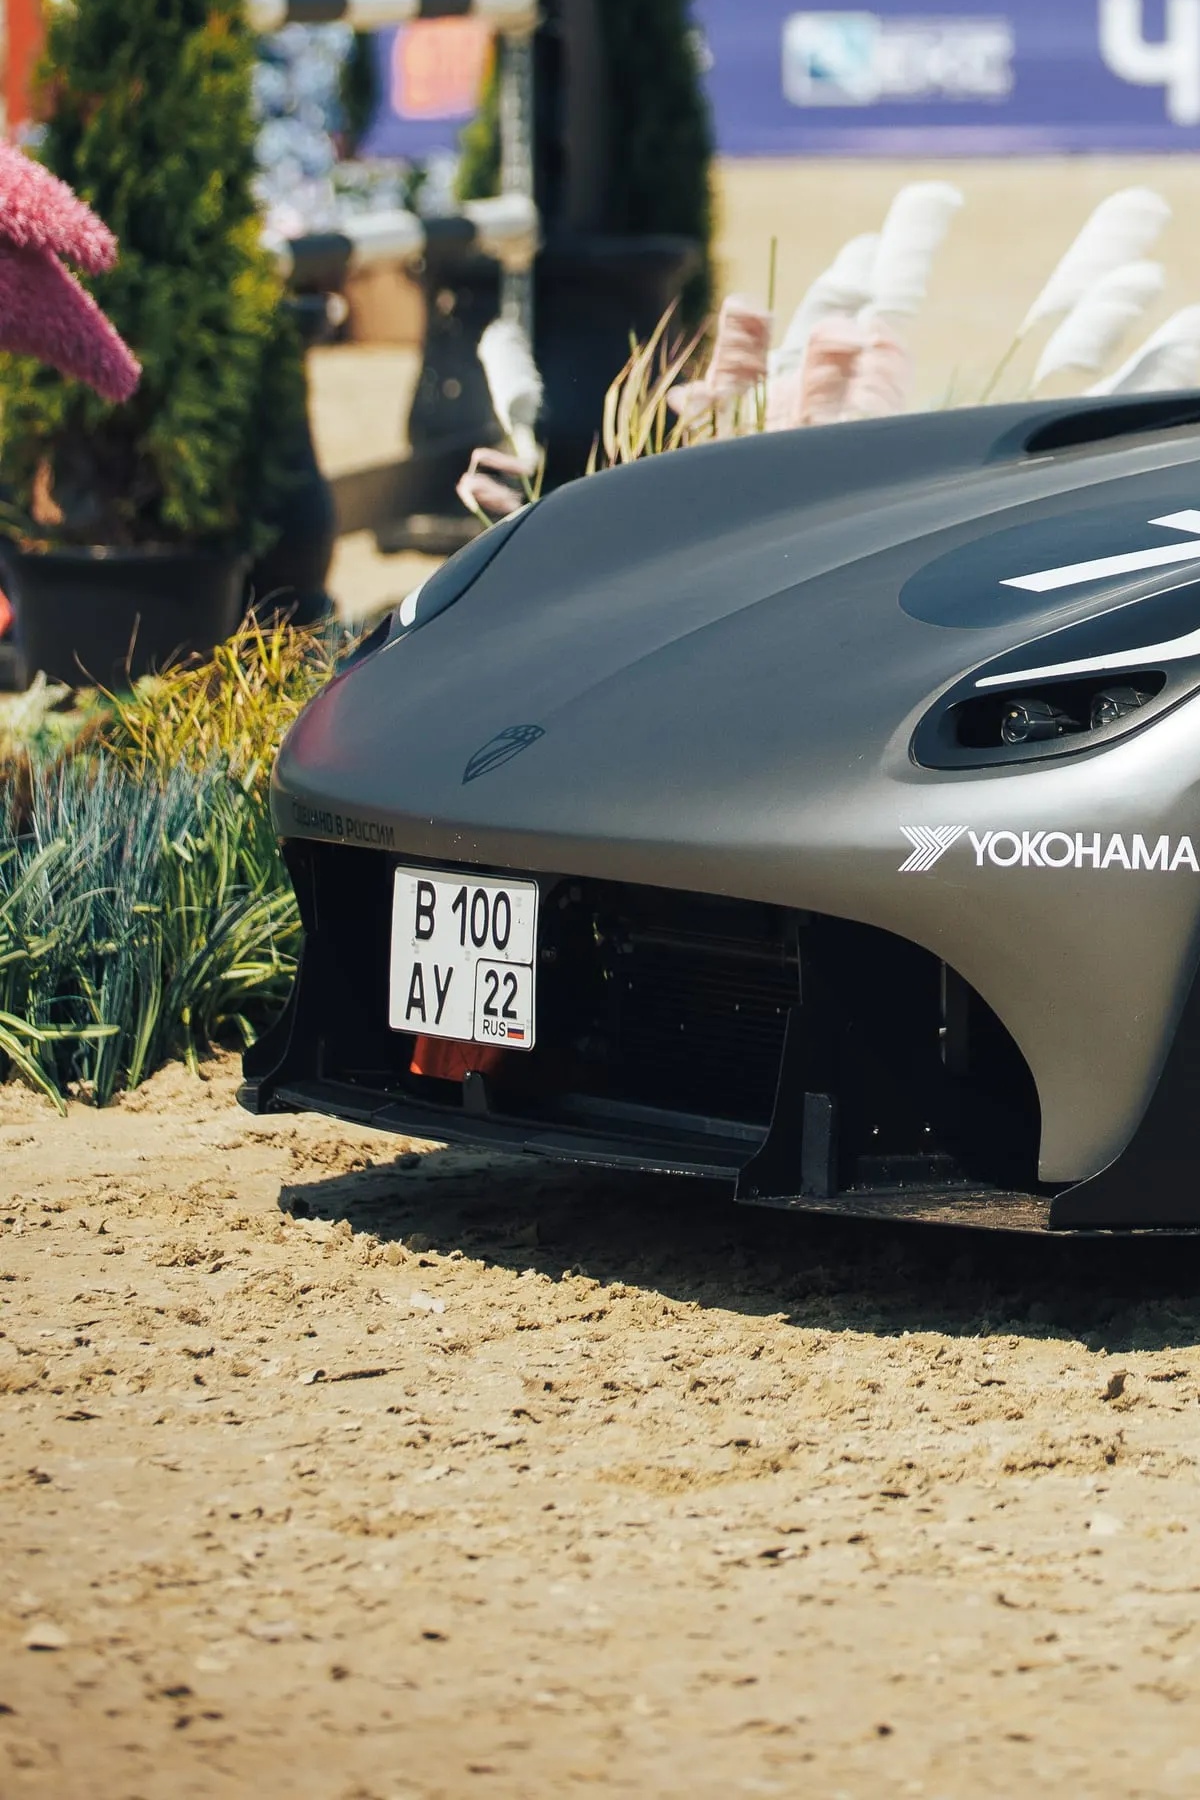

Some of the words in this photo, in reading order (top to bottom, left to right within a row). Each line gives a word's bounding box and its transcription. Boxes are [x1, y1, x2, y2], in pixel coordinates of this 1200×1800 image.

[346, 817, 396, 847] РОССИИ
[968, 830, 1200, 872] YOKOHAMA
[452, 886, 511, 950] 100
[484, 969, 518, 1019] 22
[483, 1019, 506, 1036] RUS
